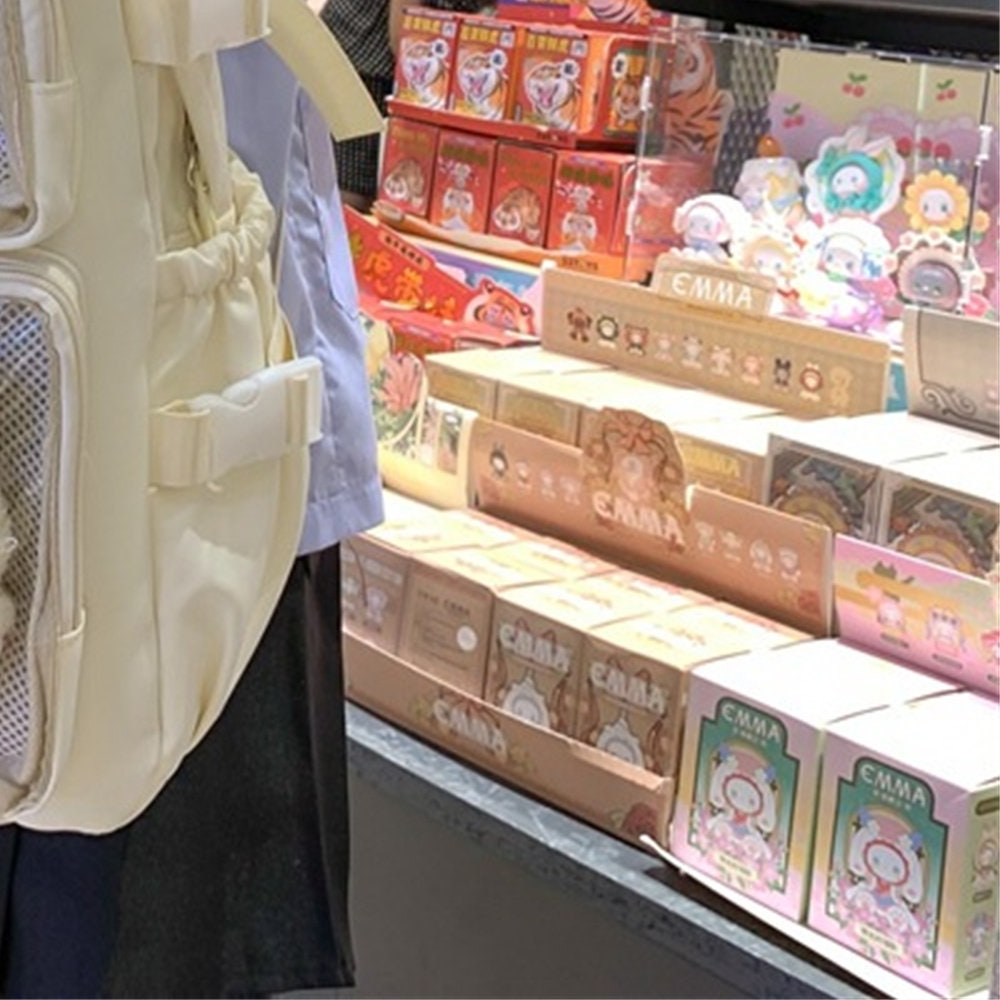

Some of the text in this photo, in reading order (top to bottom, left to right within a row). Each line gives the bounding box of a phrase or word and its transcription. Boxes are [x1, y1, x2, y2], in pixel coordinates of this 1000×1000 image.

[671, 272, 752, 309] EMMA
[591, 490, 687, 551] EMMA
[500, 622, 573, 675] EMMA
[589, 660, 667, 716] EMMA
[720, 703, 782, 744] EMMA
[860, 764, 928, 807] EMMA
